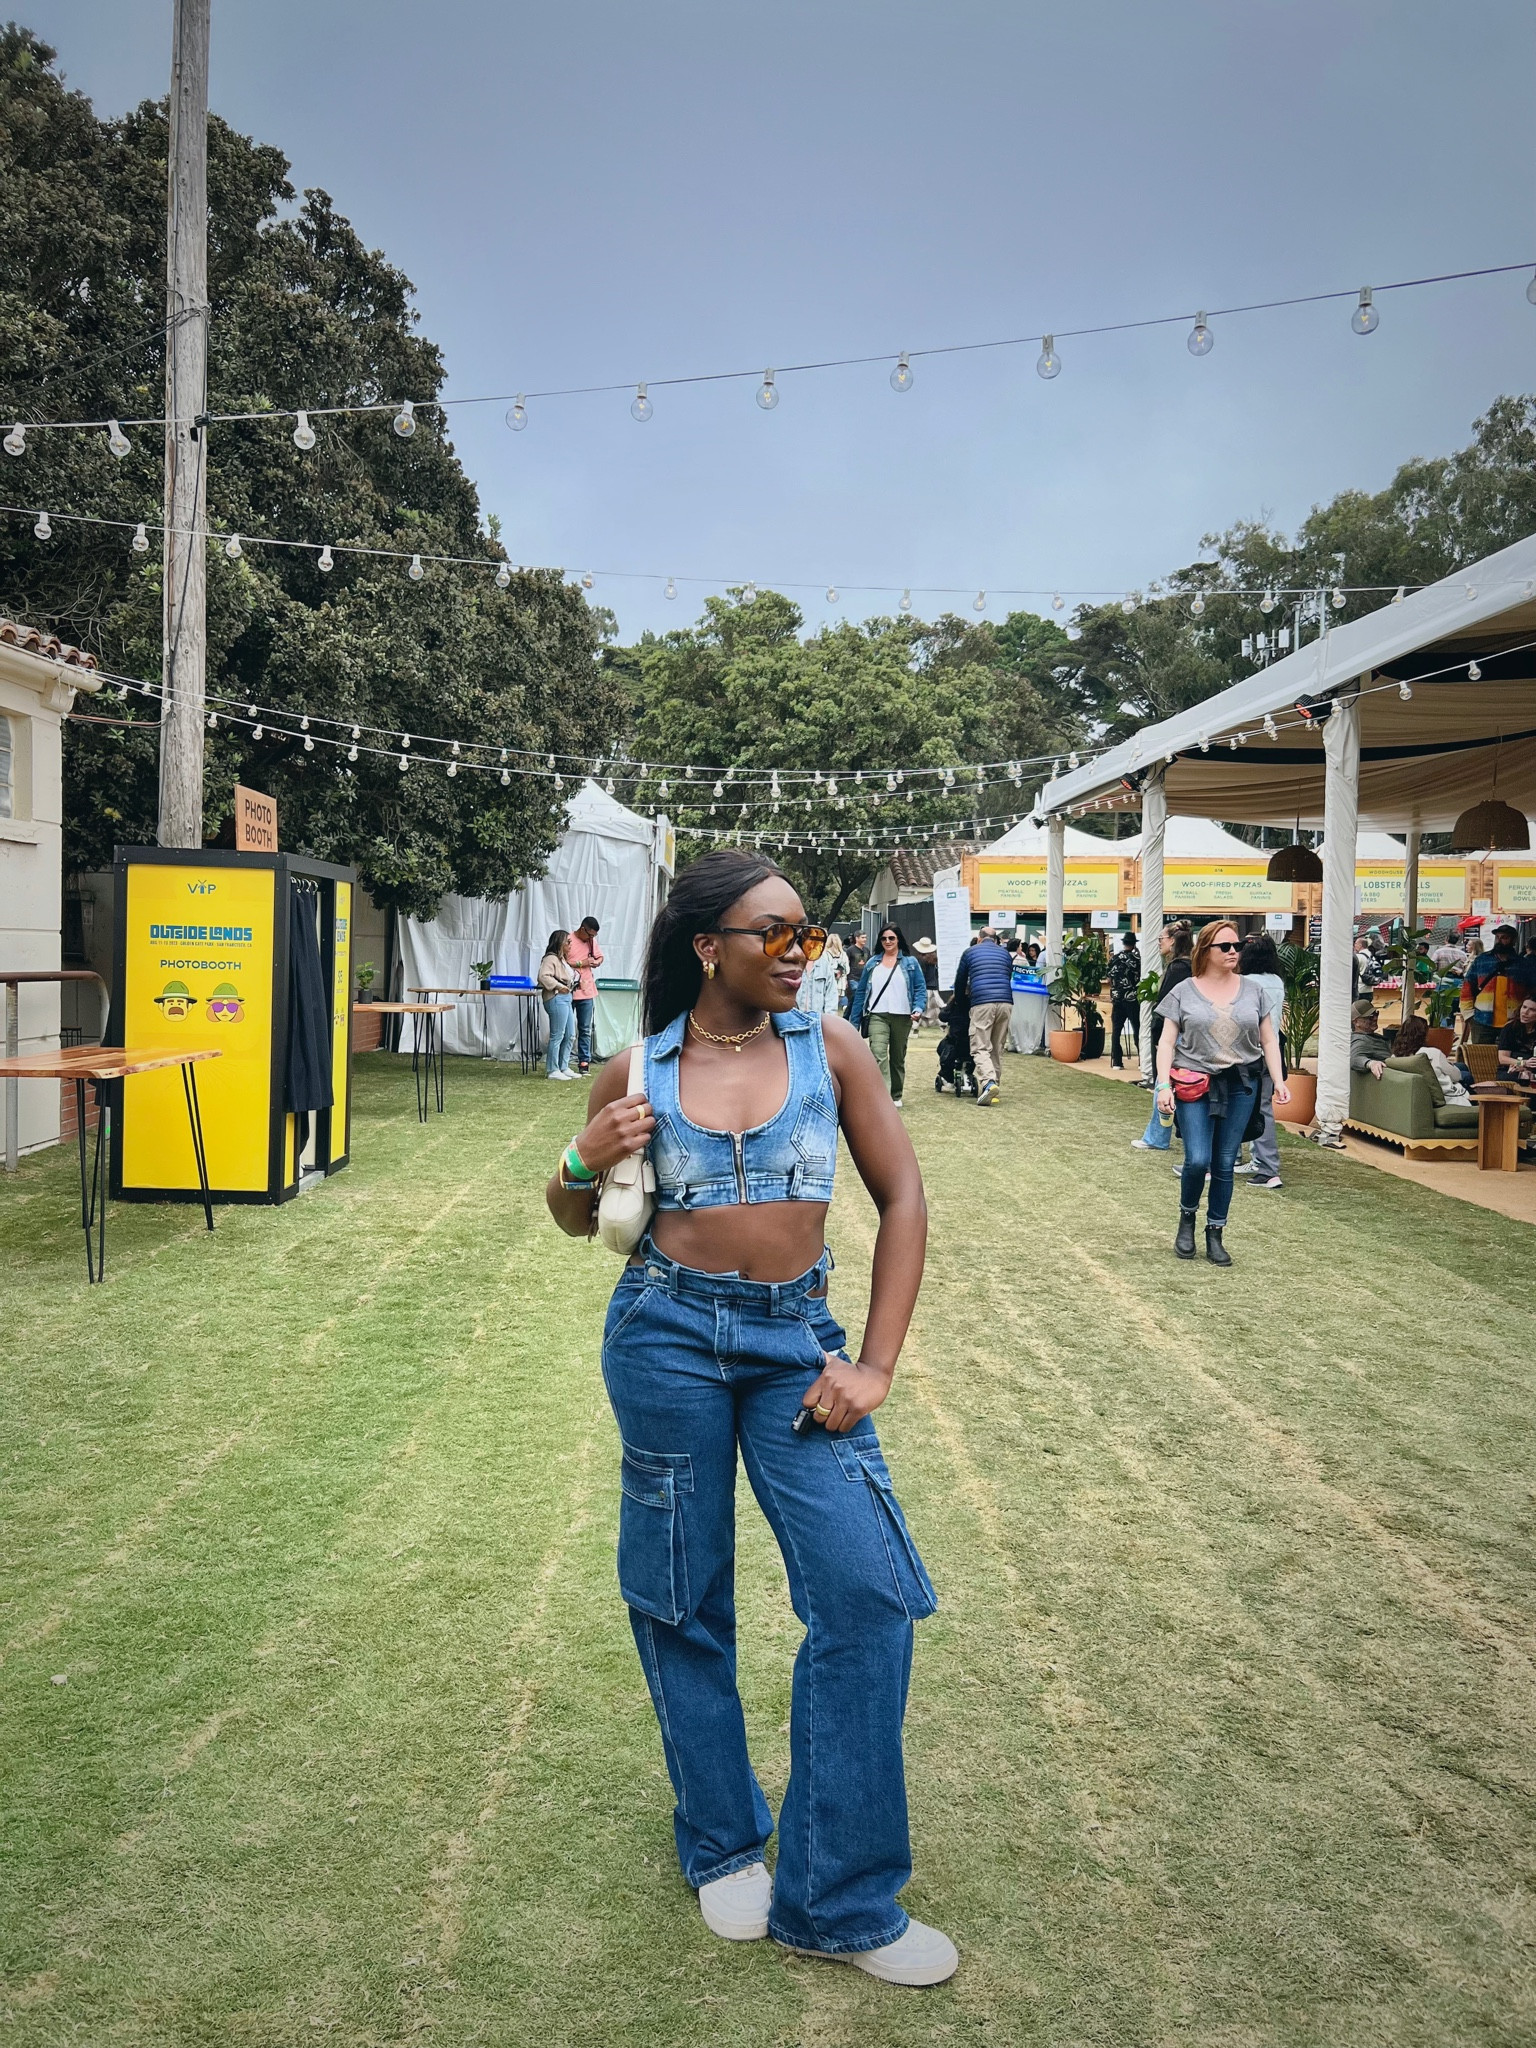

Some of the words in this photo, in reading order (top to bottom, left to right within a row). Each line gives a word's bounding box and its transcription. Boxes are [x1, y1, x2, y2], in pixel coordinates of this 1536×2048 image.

[245, 798, 272, 825] PHOTO
[246, 823, 273, 849] BOOTH
[1363, 881, 1402, 889] LOBSTER
[150, 925, 207, 940] OUTSIDE
[209, 926, 252, 941] LANDS
[160, 959, 242, 970] PHOTOBOOTH
[1015, 966, 1037, 975] RECYCL
